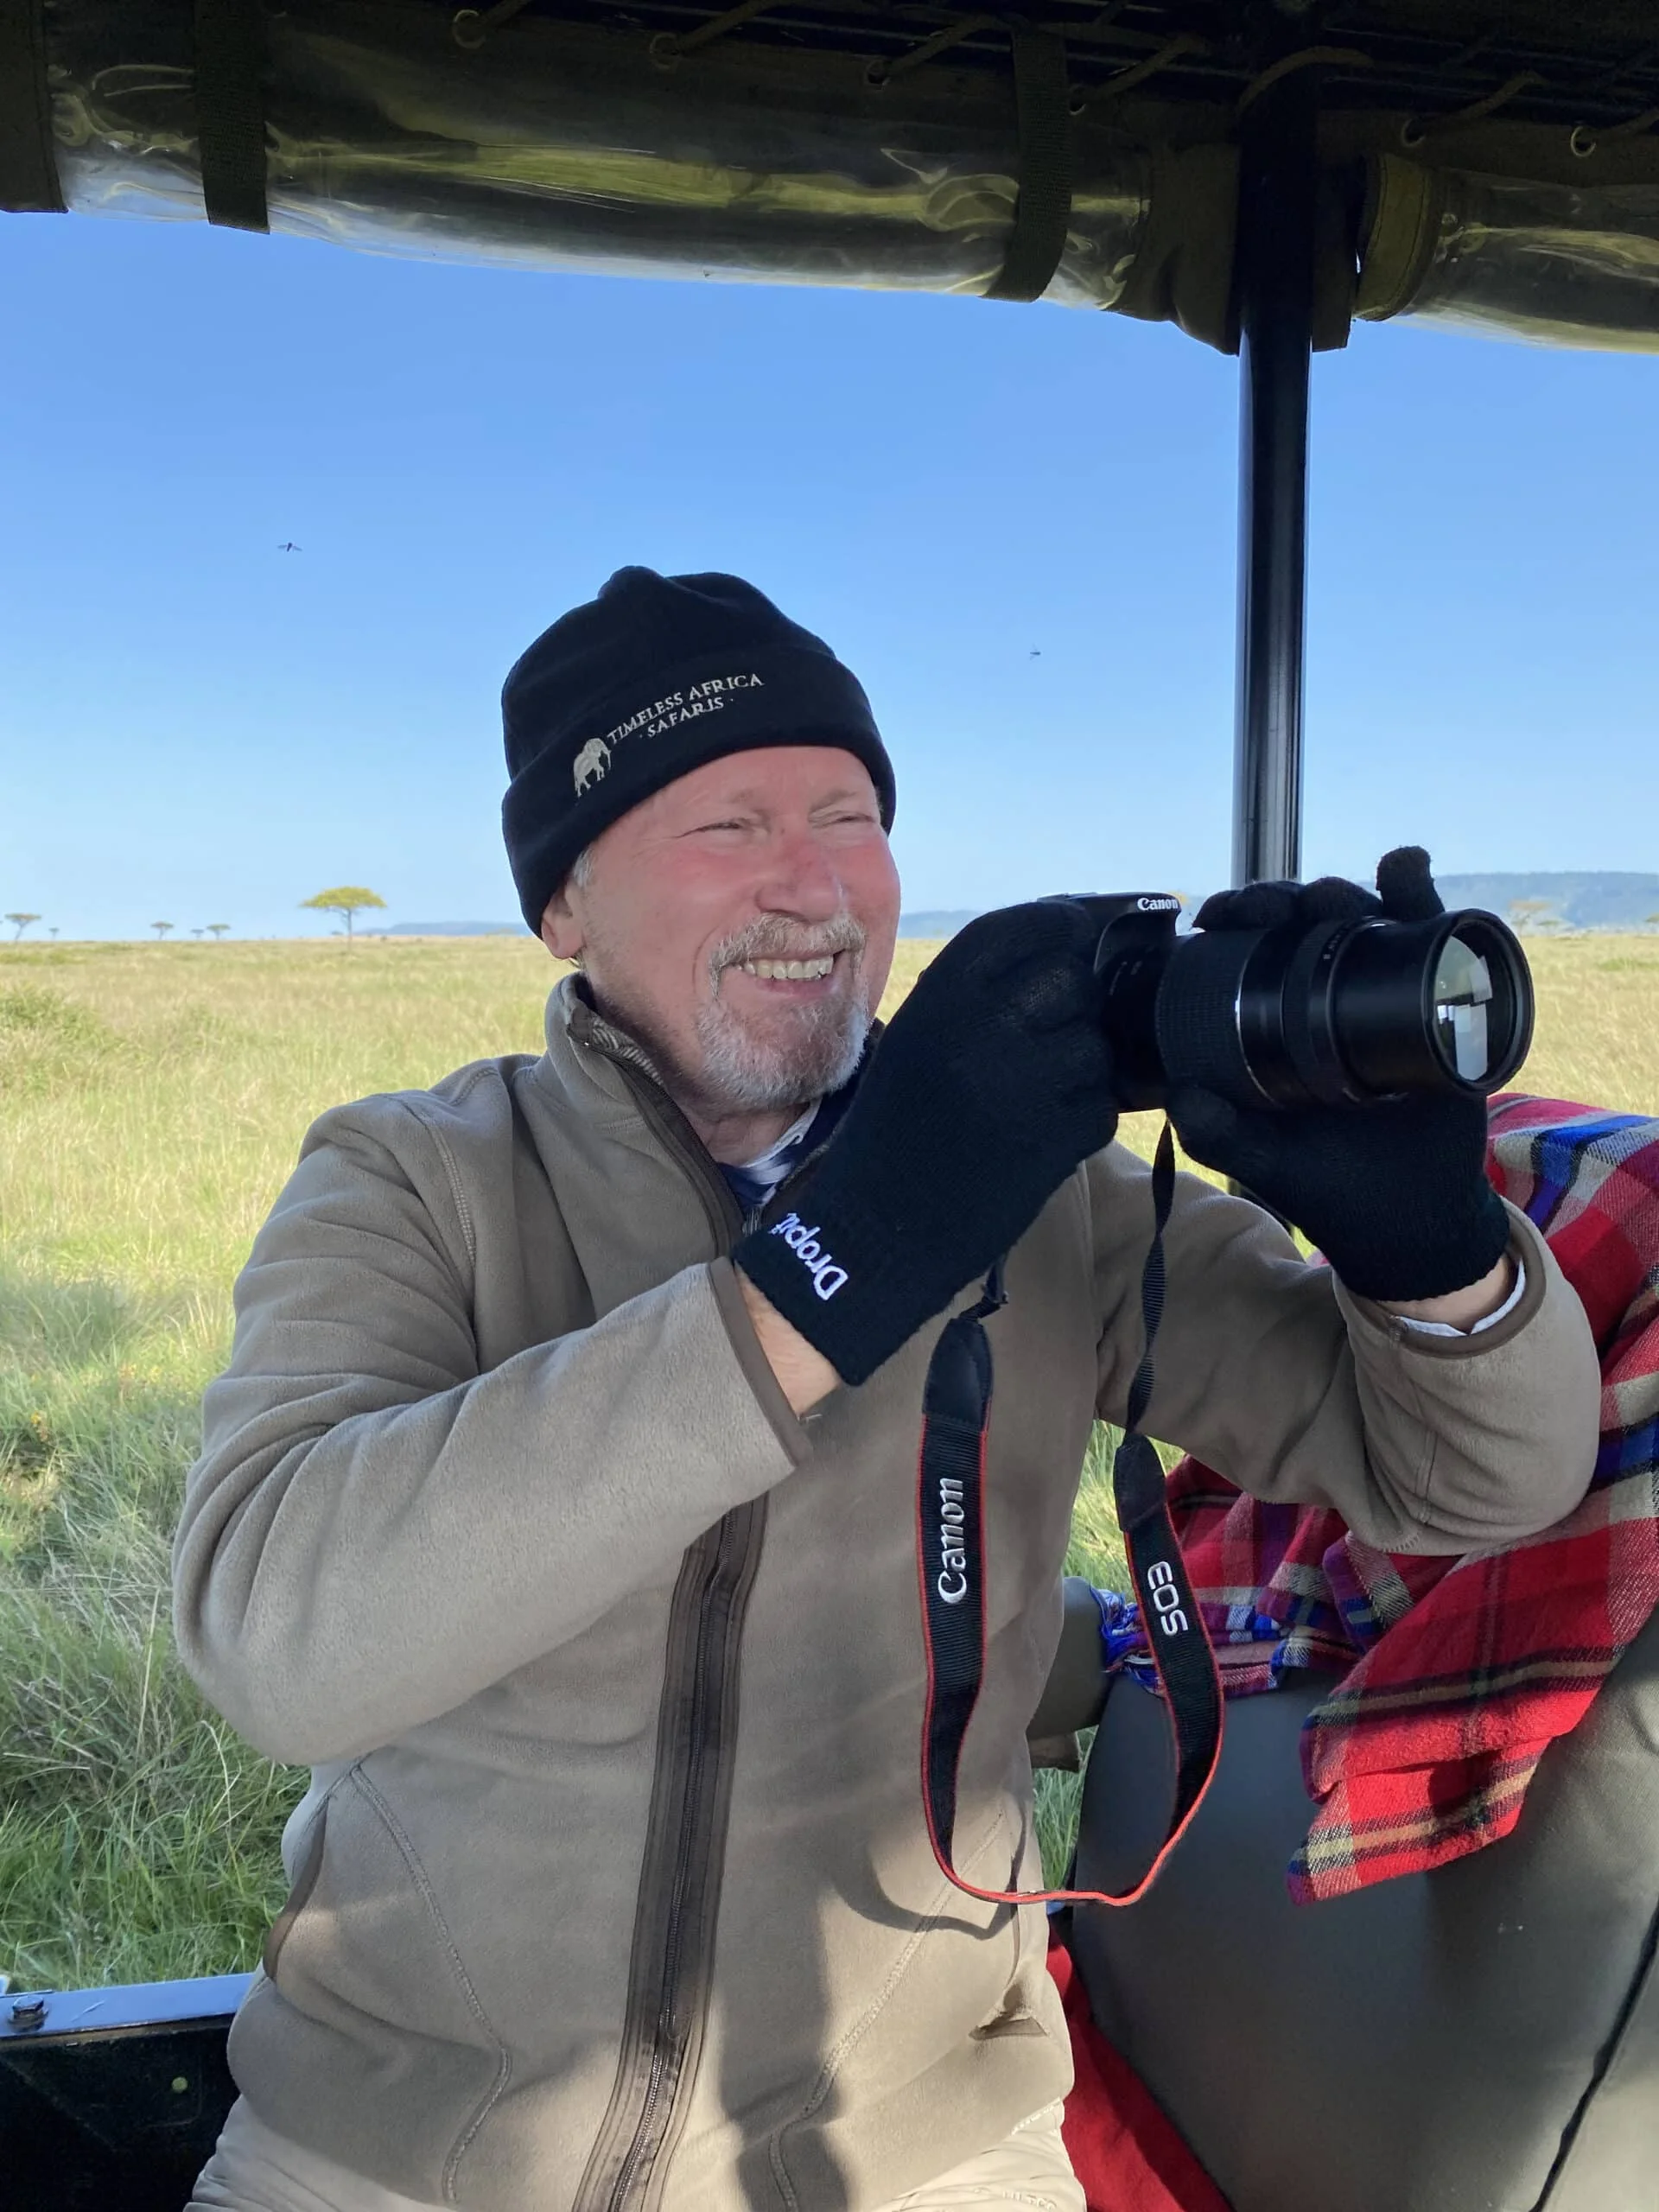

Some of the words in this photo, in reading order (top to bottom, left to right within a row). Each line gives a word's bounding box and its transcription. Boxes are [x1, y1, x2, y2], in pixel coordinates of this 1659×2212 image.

[607, 691, 683, 744] TIMELESS
[689, 673, 766, 701] AFRICA
[647, 696, 724, 737] SAFARIS
[1137, 897, 1179, 911] Canon
[938, 1478, 968, 1604] Canon
[1147, 1560, 1188, 1637] EOS
